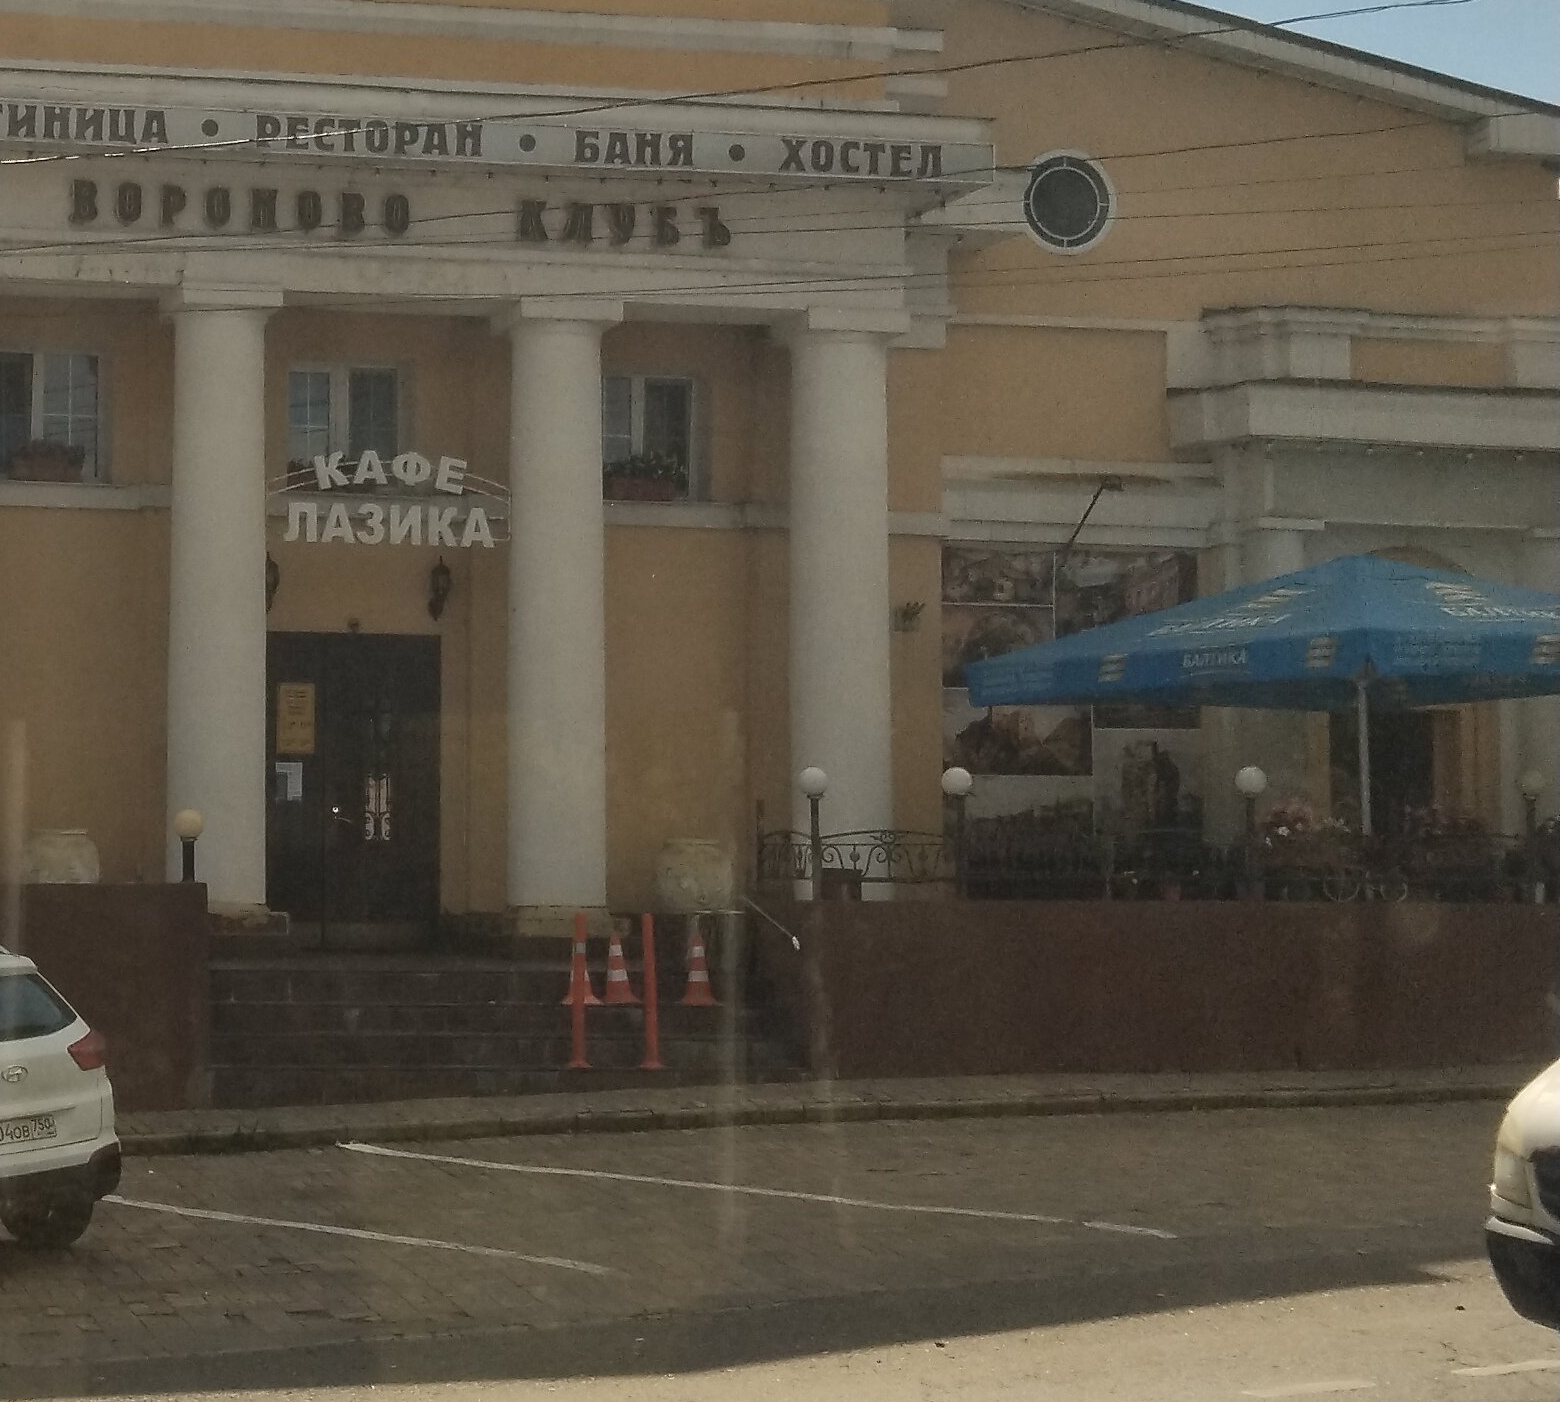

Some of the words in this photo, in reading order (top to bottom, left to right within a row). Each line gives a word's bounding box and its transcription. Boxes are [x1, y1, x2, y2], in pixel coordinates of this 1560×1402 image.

[255, 115, 483, 157] РЕСТОРАН
[574, 129, 694, 167] БАНЯ
[778, 137, 942, 178] ХОСТЕЛ
[68, 179, 411, 237] ВОРОНОВО
[517, 199, 732, 248] КЛУБЪ
[313, 450, 468, 495] КАФЕ
[284, 501, 495, 548] ЛАЗИКА
